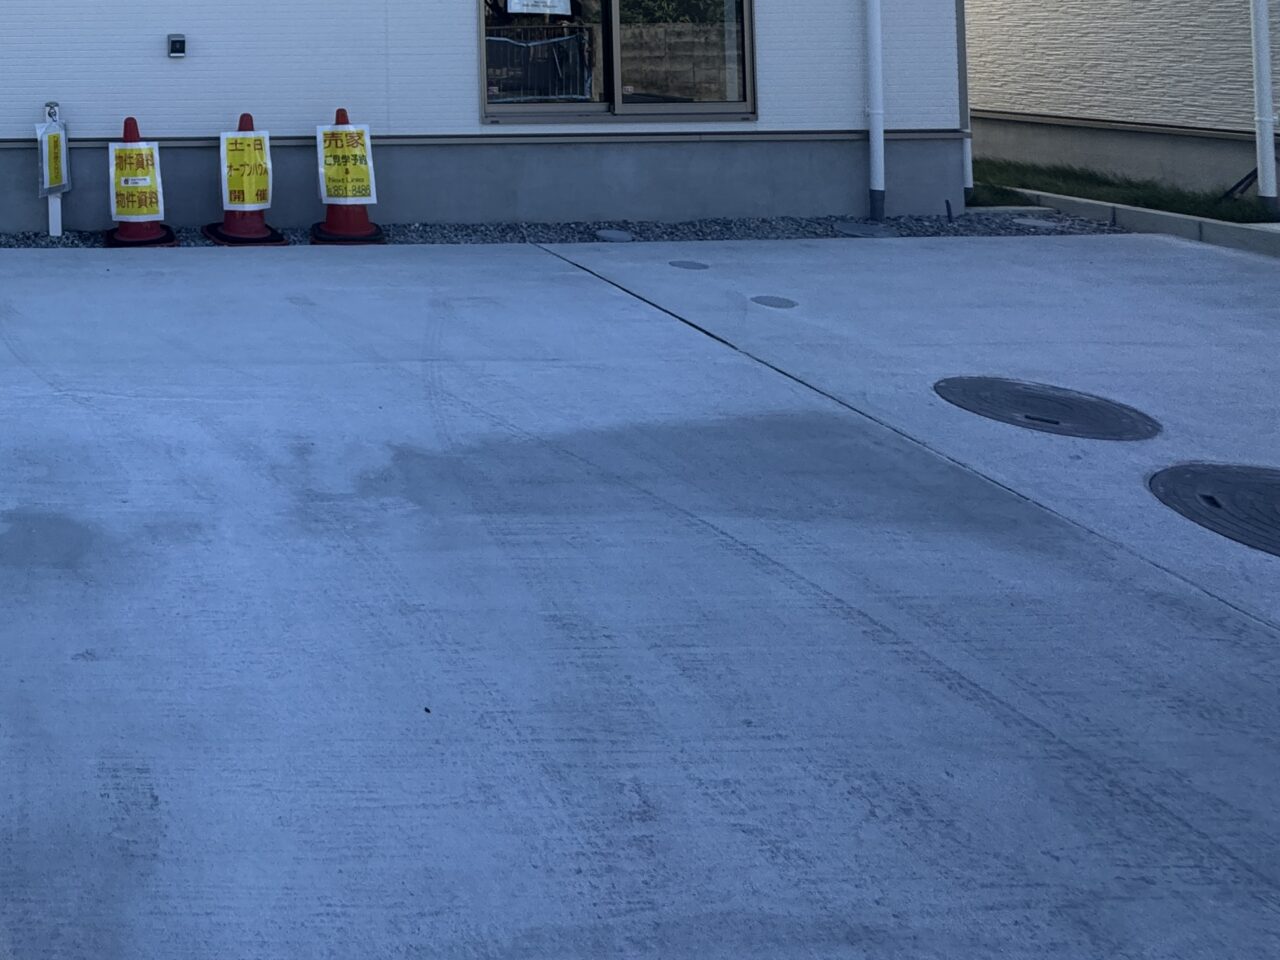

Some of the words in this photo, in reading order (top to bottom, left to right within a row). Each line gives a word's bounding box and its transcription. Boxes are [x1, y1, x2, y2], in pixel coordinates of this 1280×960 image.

[228, 139, 263, 151] 土・日
[323, 131, 365, 149] 売家
[116, 152, 154, 170] 物件資料
[116, 190, 159, 208] 物件資料
[230, 188, 269, 201] 開催
